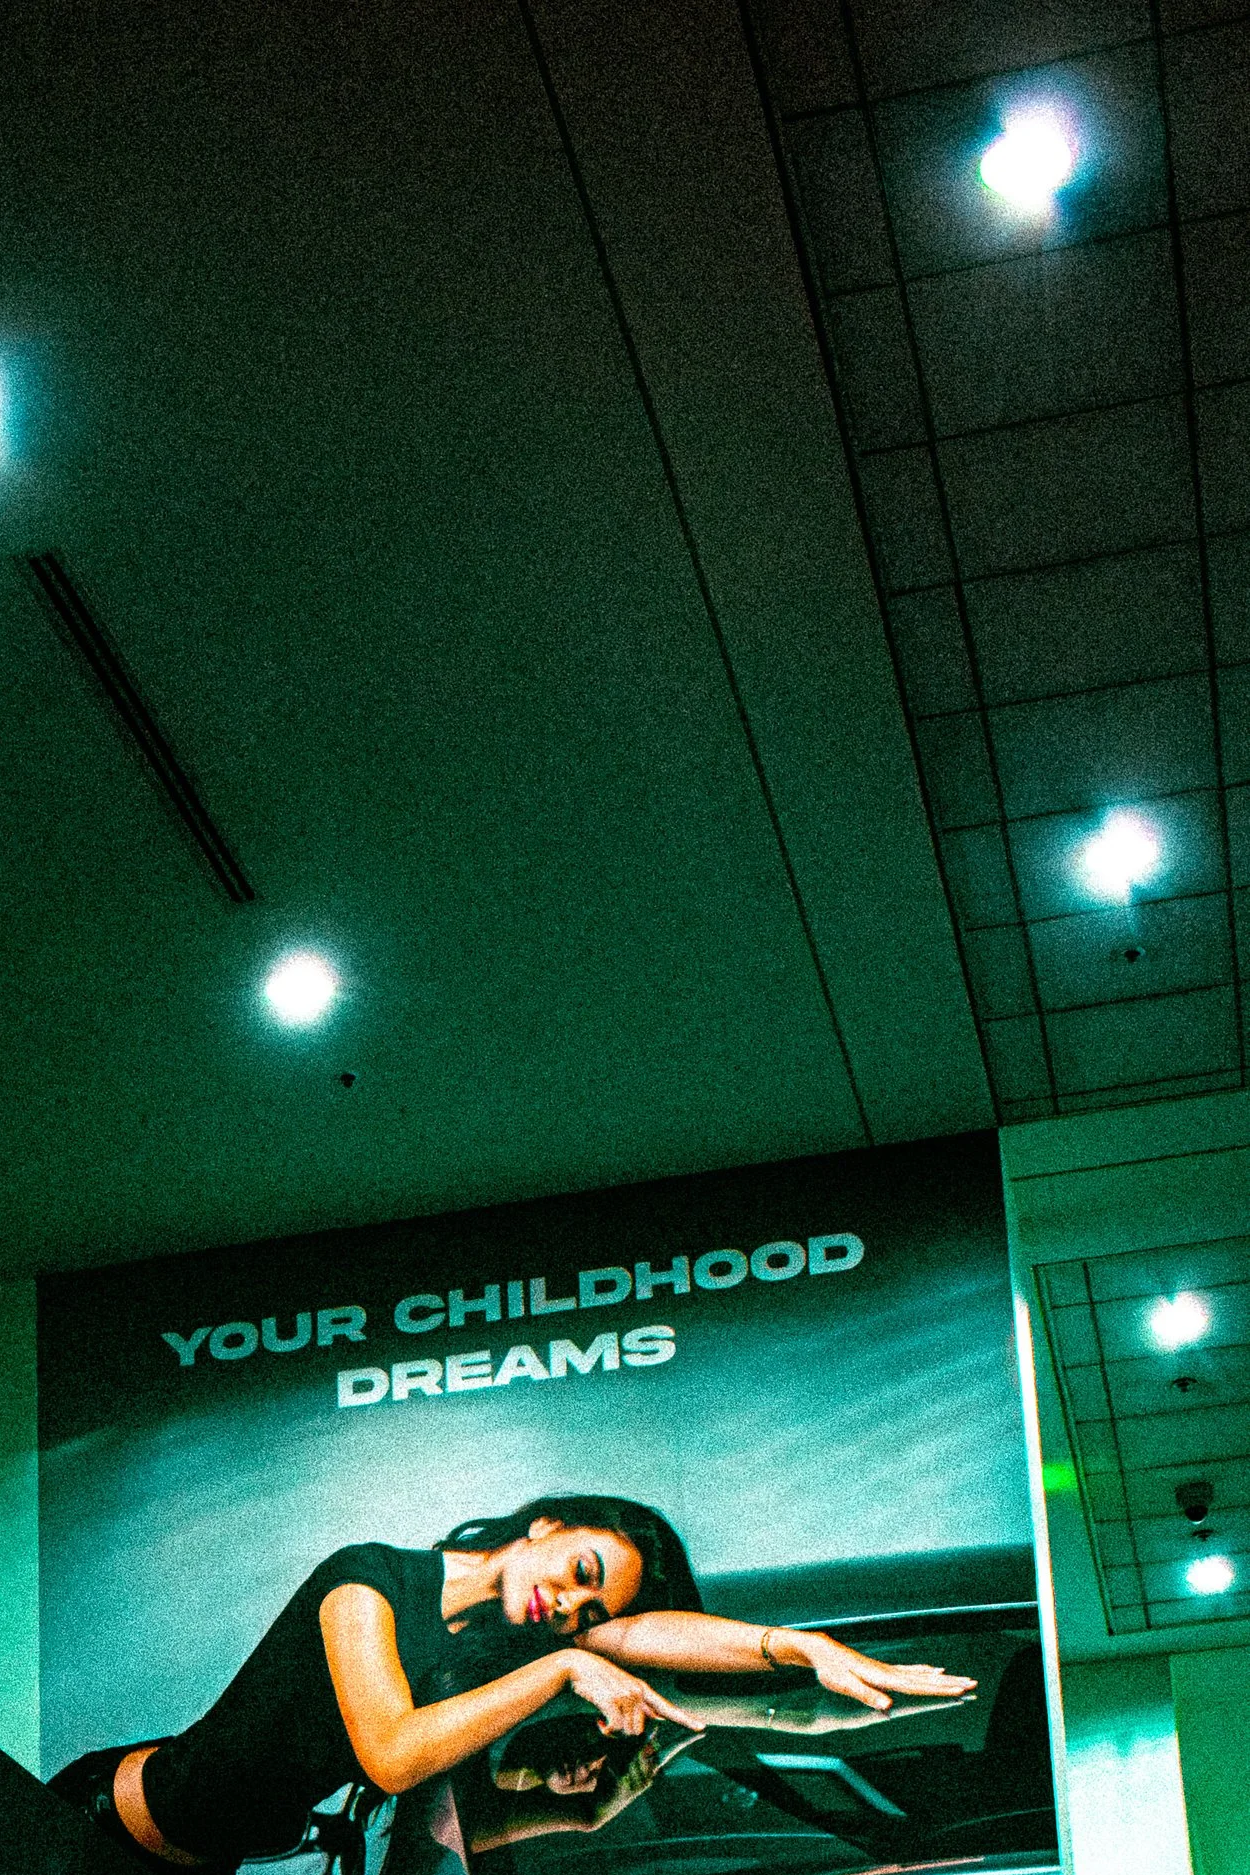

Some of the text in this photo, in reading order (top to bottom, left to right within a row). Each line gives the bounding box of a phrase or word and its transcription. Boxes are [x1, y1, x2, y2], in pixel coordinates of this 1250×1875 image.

[162, 1233, 865, 1366] YOUR CHILDHOOD
[337, 1326, 676, 1408] DREAMS
